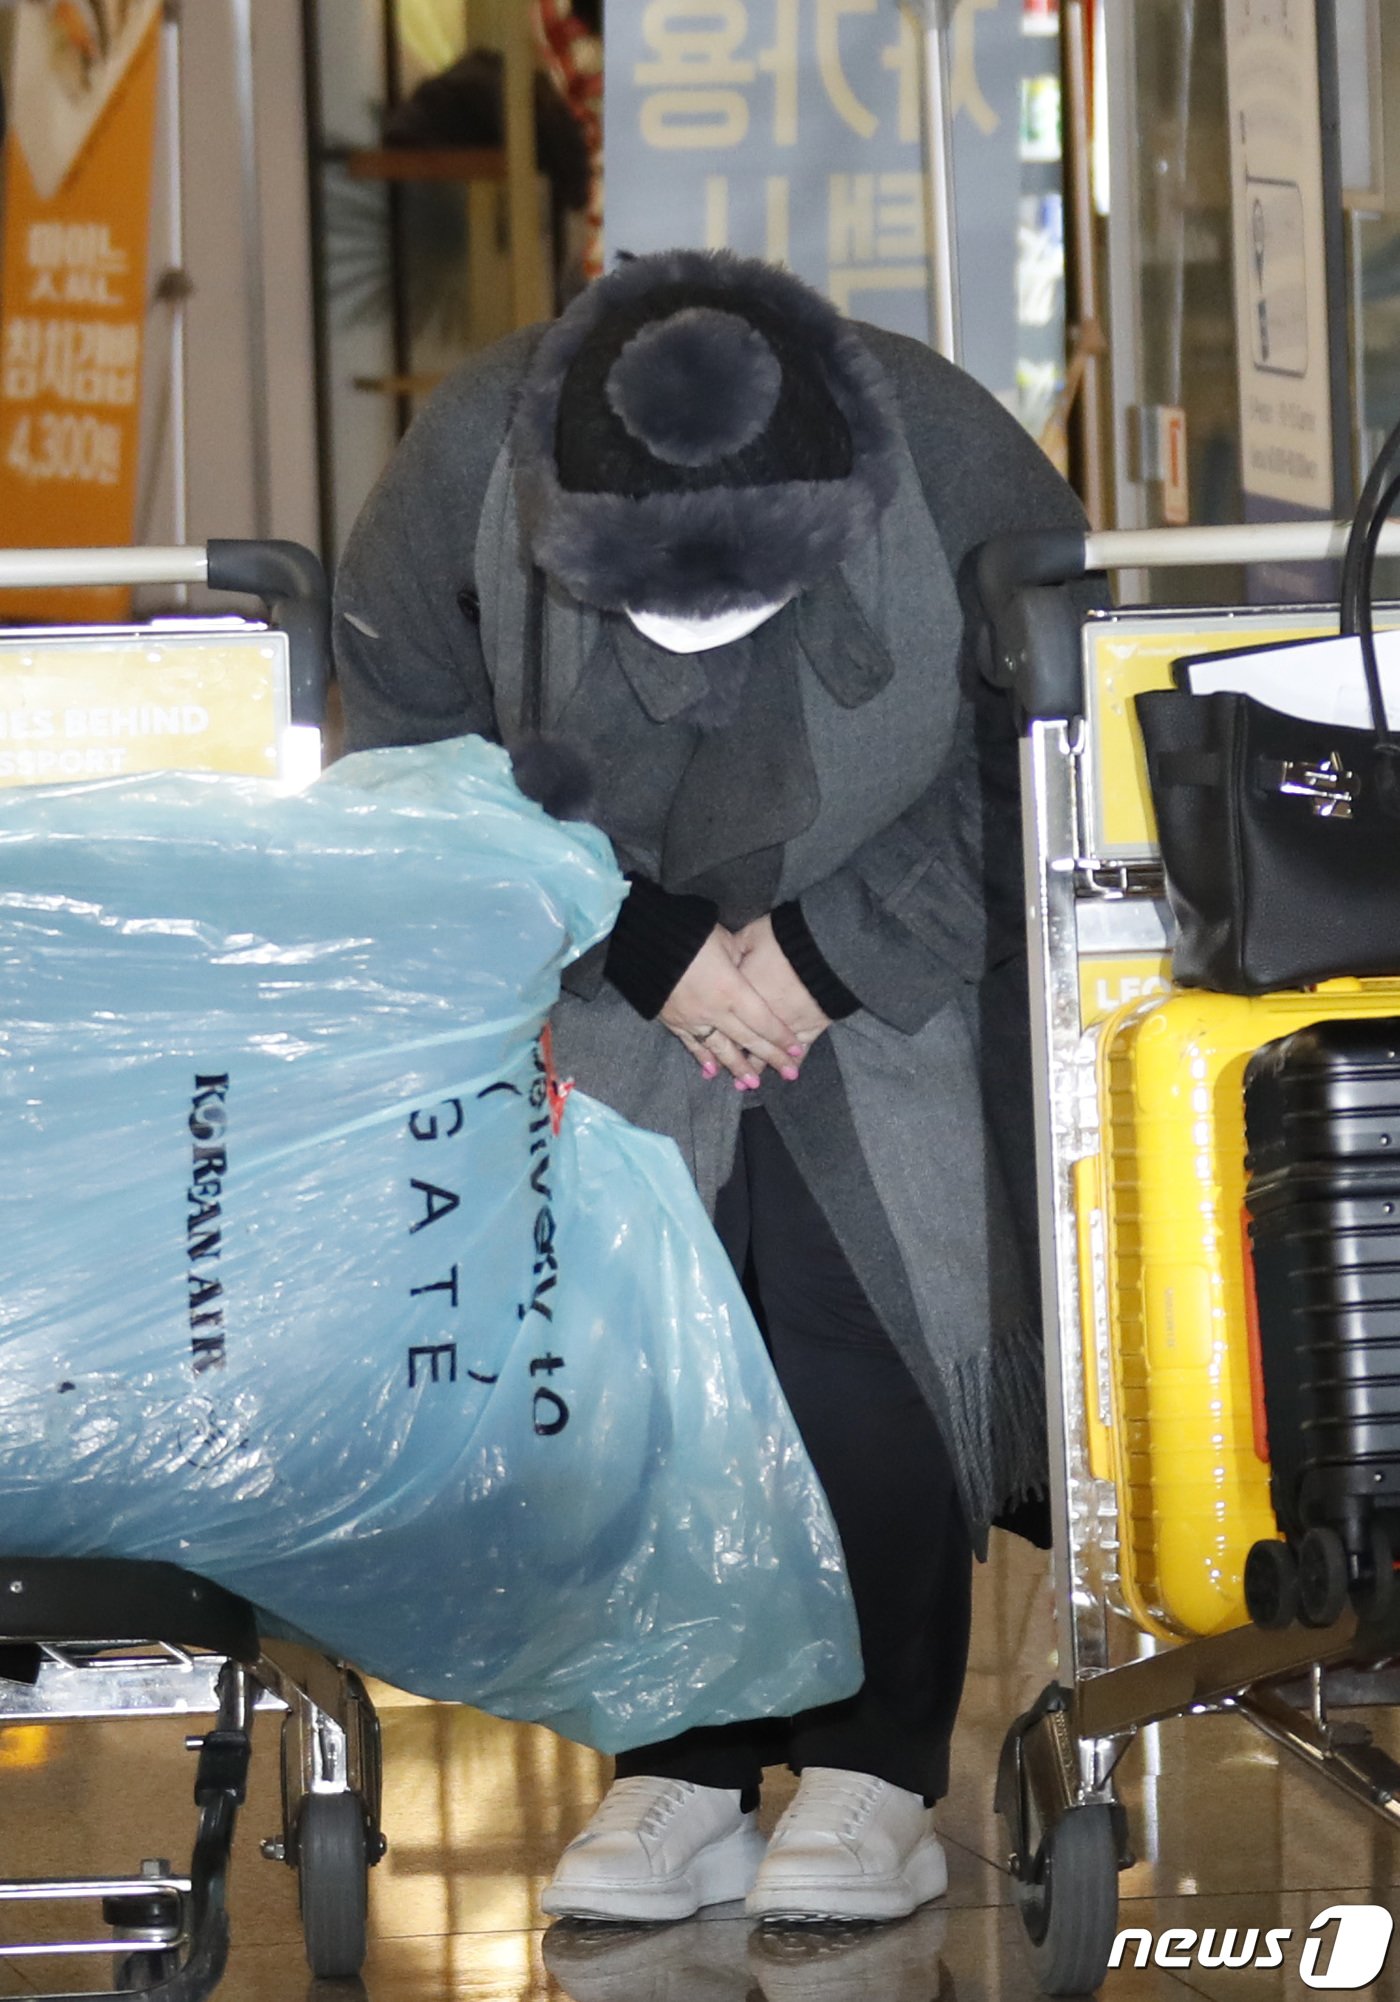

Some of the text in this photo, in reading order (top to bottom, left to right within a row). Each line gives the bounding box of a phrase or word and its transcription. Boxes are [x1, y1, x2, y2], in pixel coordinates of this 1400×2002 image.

[63, 704, 210, 738] BEHIND
[408, 1097, 464, 1388] GATE
[187, 1272, 226, 1377] AIR
[530, 1351, 570, 1437] to
